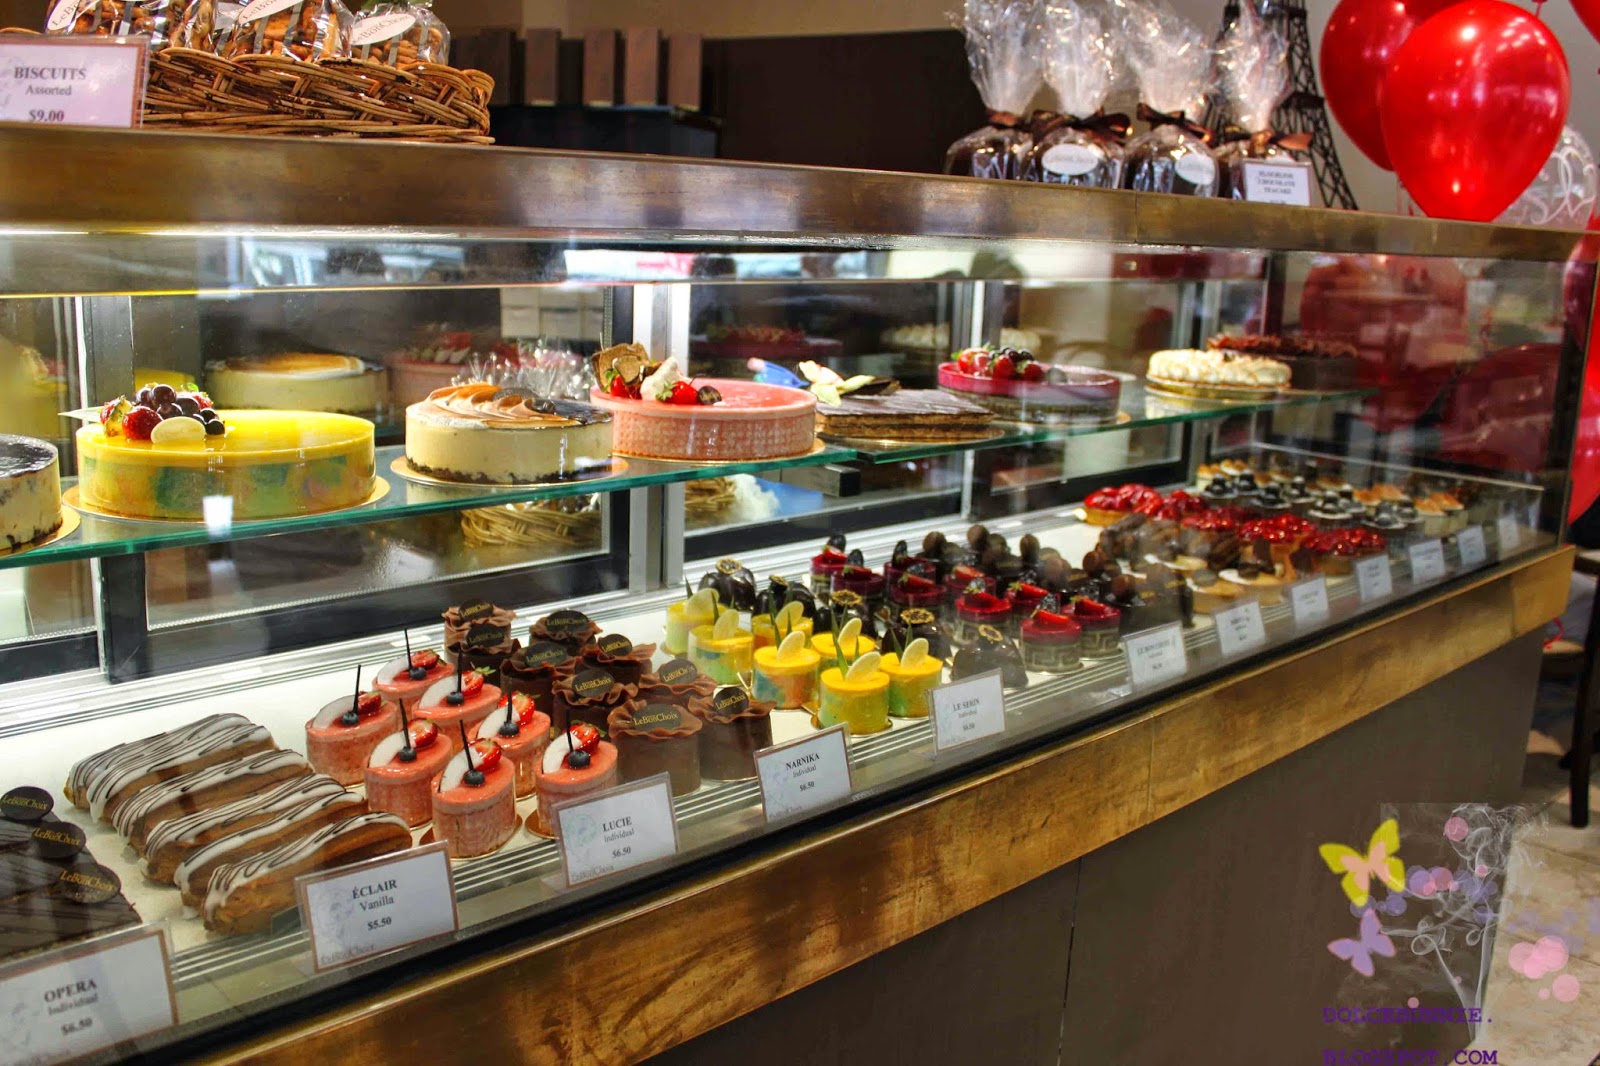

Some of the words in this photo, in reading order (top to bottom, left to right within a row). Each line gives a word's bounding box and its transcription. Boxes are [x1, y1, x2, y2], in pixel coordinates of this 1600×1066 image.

[14, 66, 87, 80] BISCUITS
[26, 85, 72, 96] Assorted
[29, 109, 65, 122] $9.00
[953, 702, 962, 711] LE
[962, 698, 980, 709] SERIN
[786, 752, 820, 770] NARNIKA
[799, 781, 815, 792] $6.50
[602, 816, 633, 832] LUCIE
[612, 846, 632, 858] $6.50
[352, 879, 398, 899] ÉCLAIR
[359, 895, 395, 912] Vanilla
[367, 917, 392, 931] $5.50
[44, 978, 98, 1003] OPERA
[61, 1017, 93, 1036] $6.50
